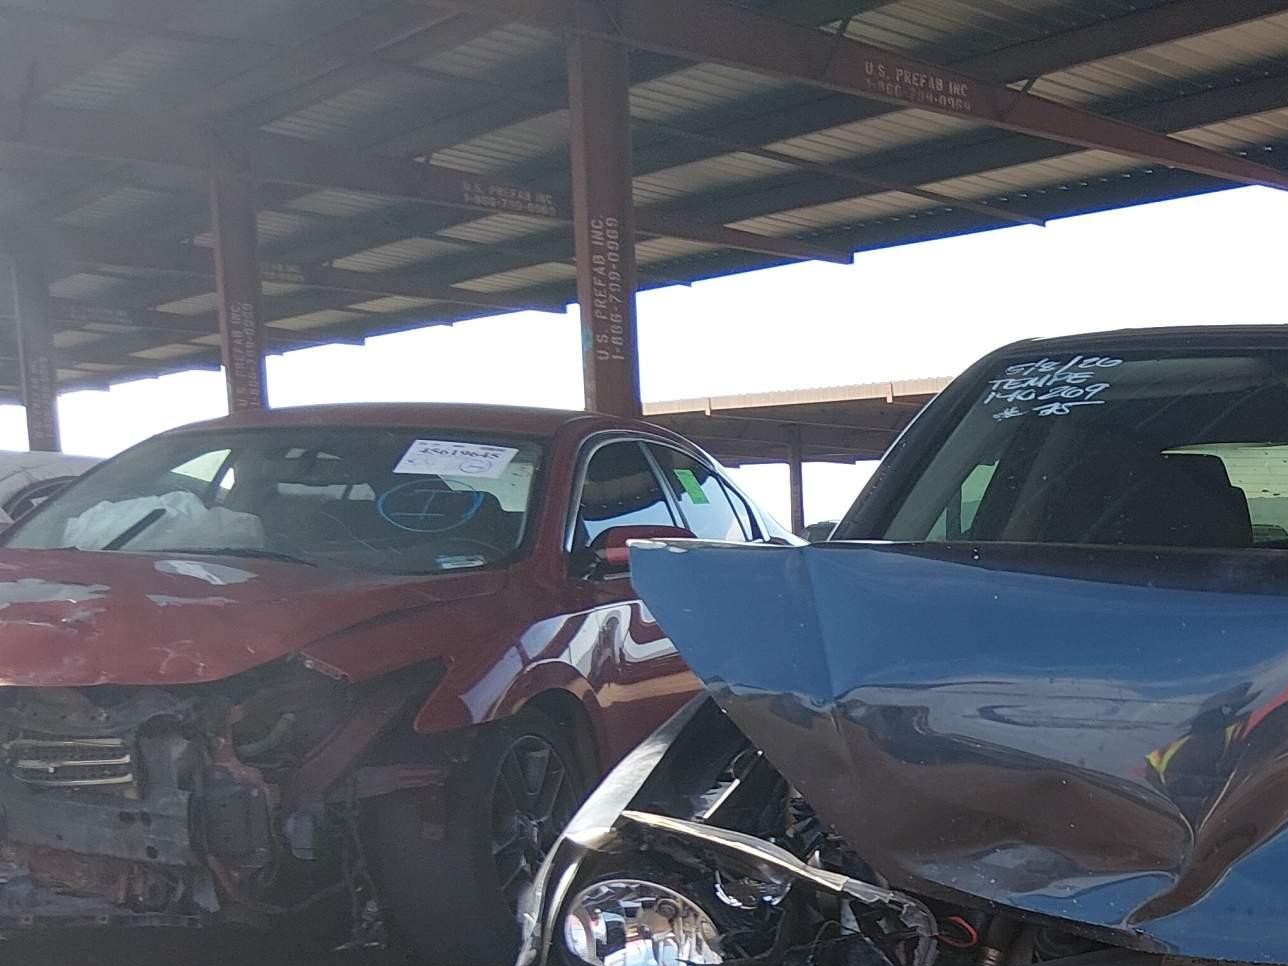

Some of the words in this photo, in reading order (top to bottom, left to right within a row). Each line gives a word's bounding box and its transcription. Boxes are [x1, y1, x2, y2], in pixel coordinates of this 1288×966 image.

[864, 60, 890, 80] U.S.
[895, 67, 945, 92] PREFAB
[592, 254, 609, 320] PREFAB
[988, 371, 1095, 391] TEMPE
